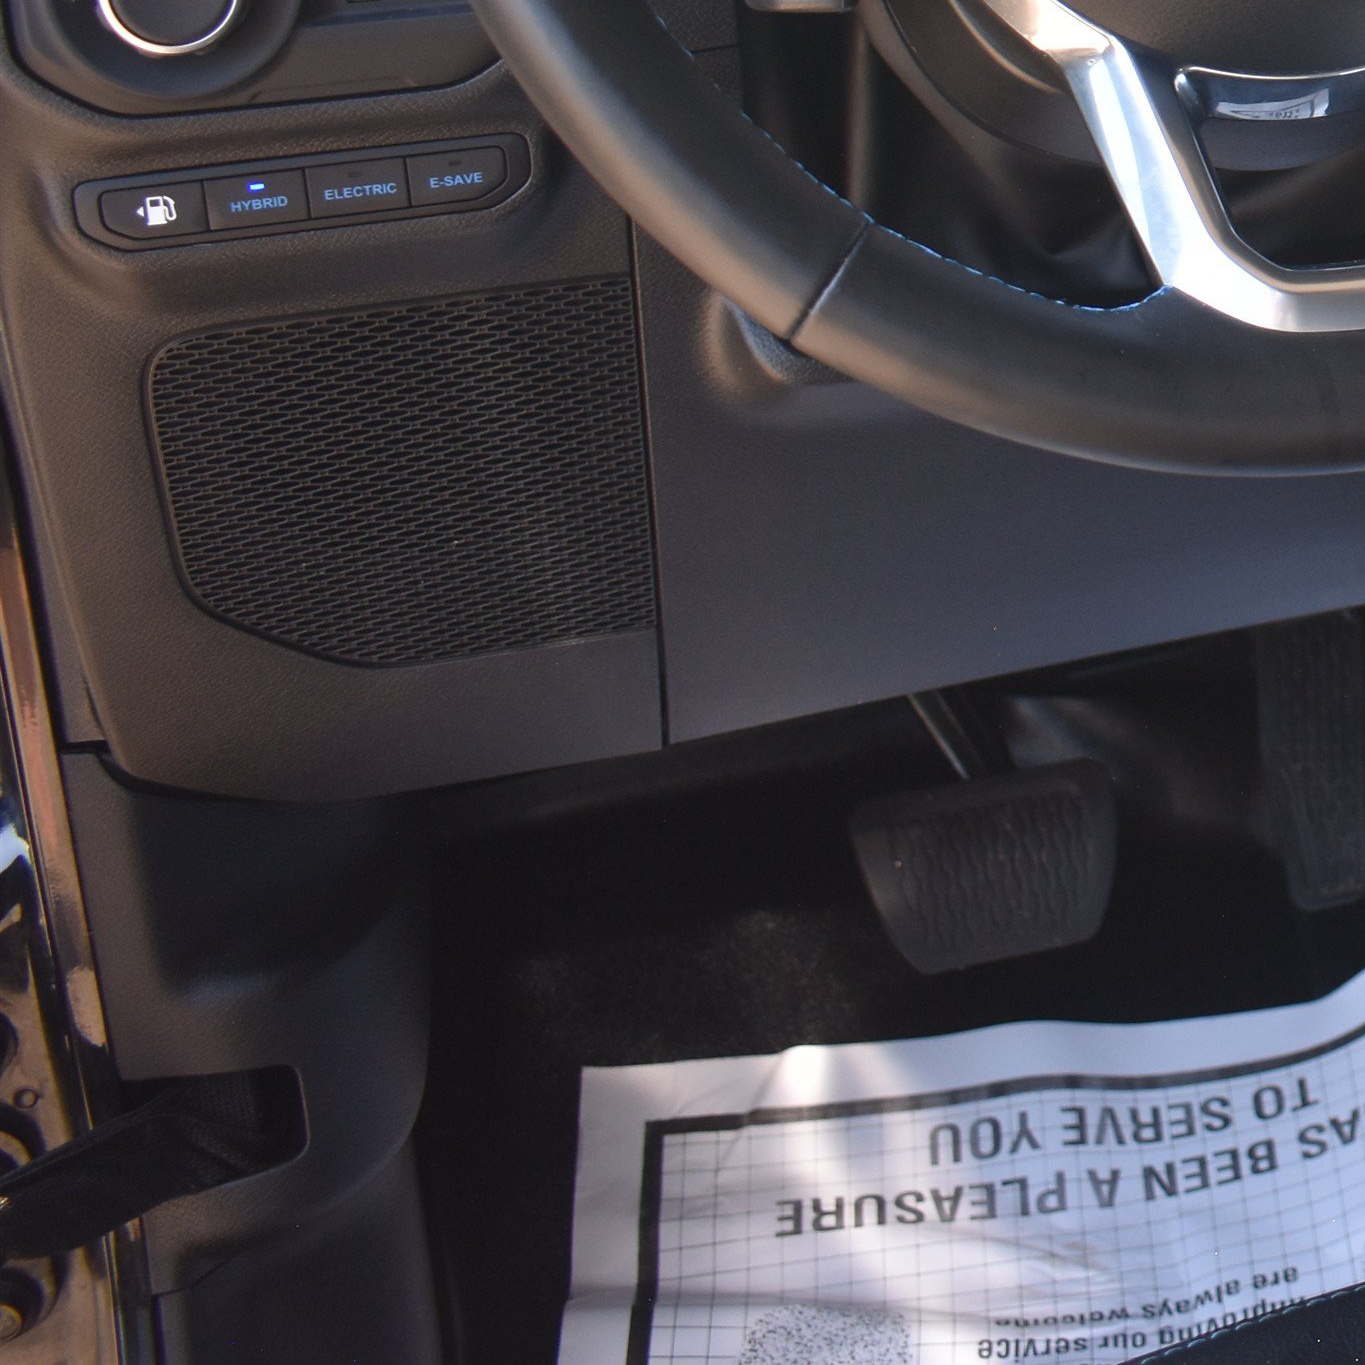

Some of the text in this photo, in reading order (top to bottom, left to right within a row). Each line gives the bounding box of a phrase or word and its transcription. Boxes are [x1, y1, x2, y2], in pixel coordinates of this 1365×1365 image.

[323, 181, 398, 202] ELECTRIC
[428, 170, 484, 191] E-SAVE
[229, 194, 289, 214] HYBRID
[929, 1075, 1320, 1166] TO SERVE YOU
[1143, 1138, 1279, 1202] BEEN
[1087, 1167, 1121, 1208] A
[775, 1170, 1068, 1238] PLEASURE
[1251, 1265, 1298, 1290] are
[1141, 1278, 1241, 1318] always
[977, 1336, 1088, 1362] service
[1101, 1331, 1148, 1349] our
